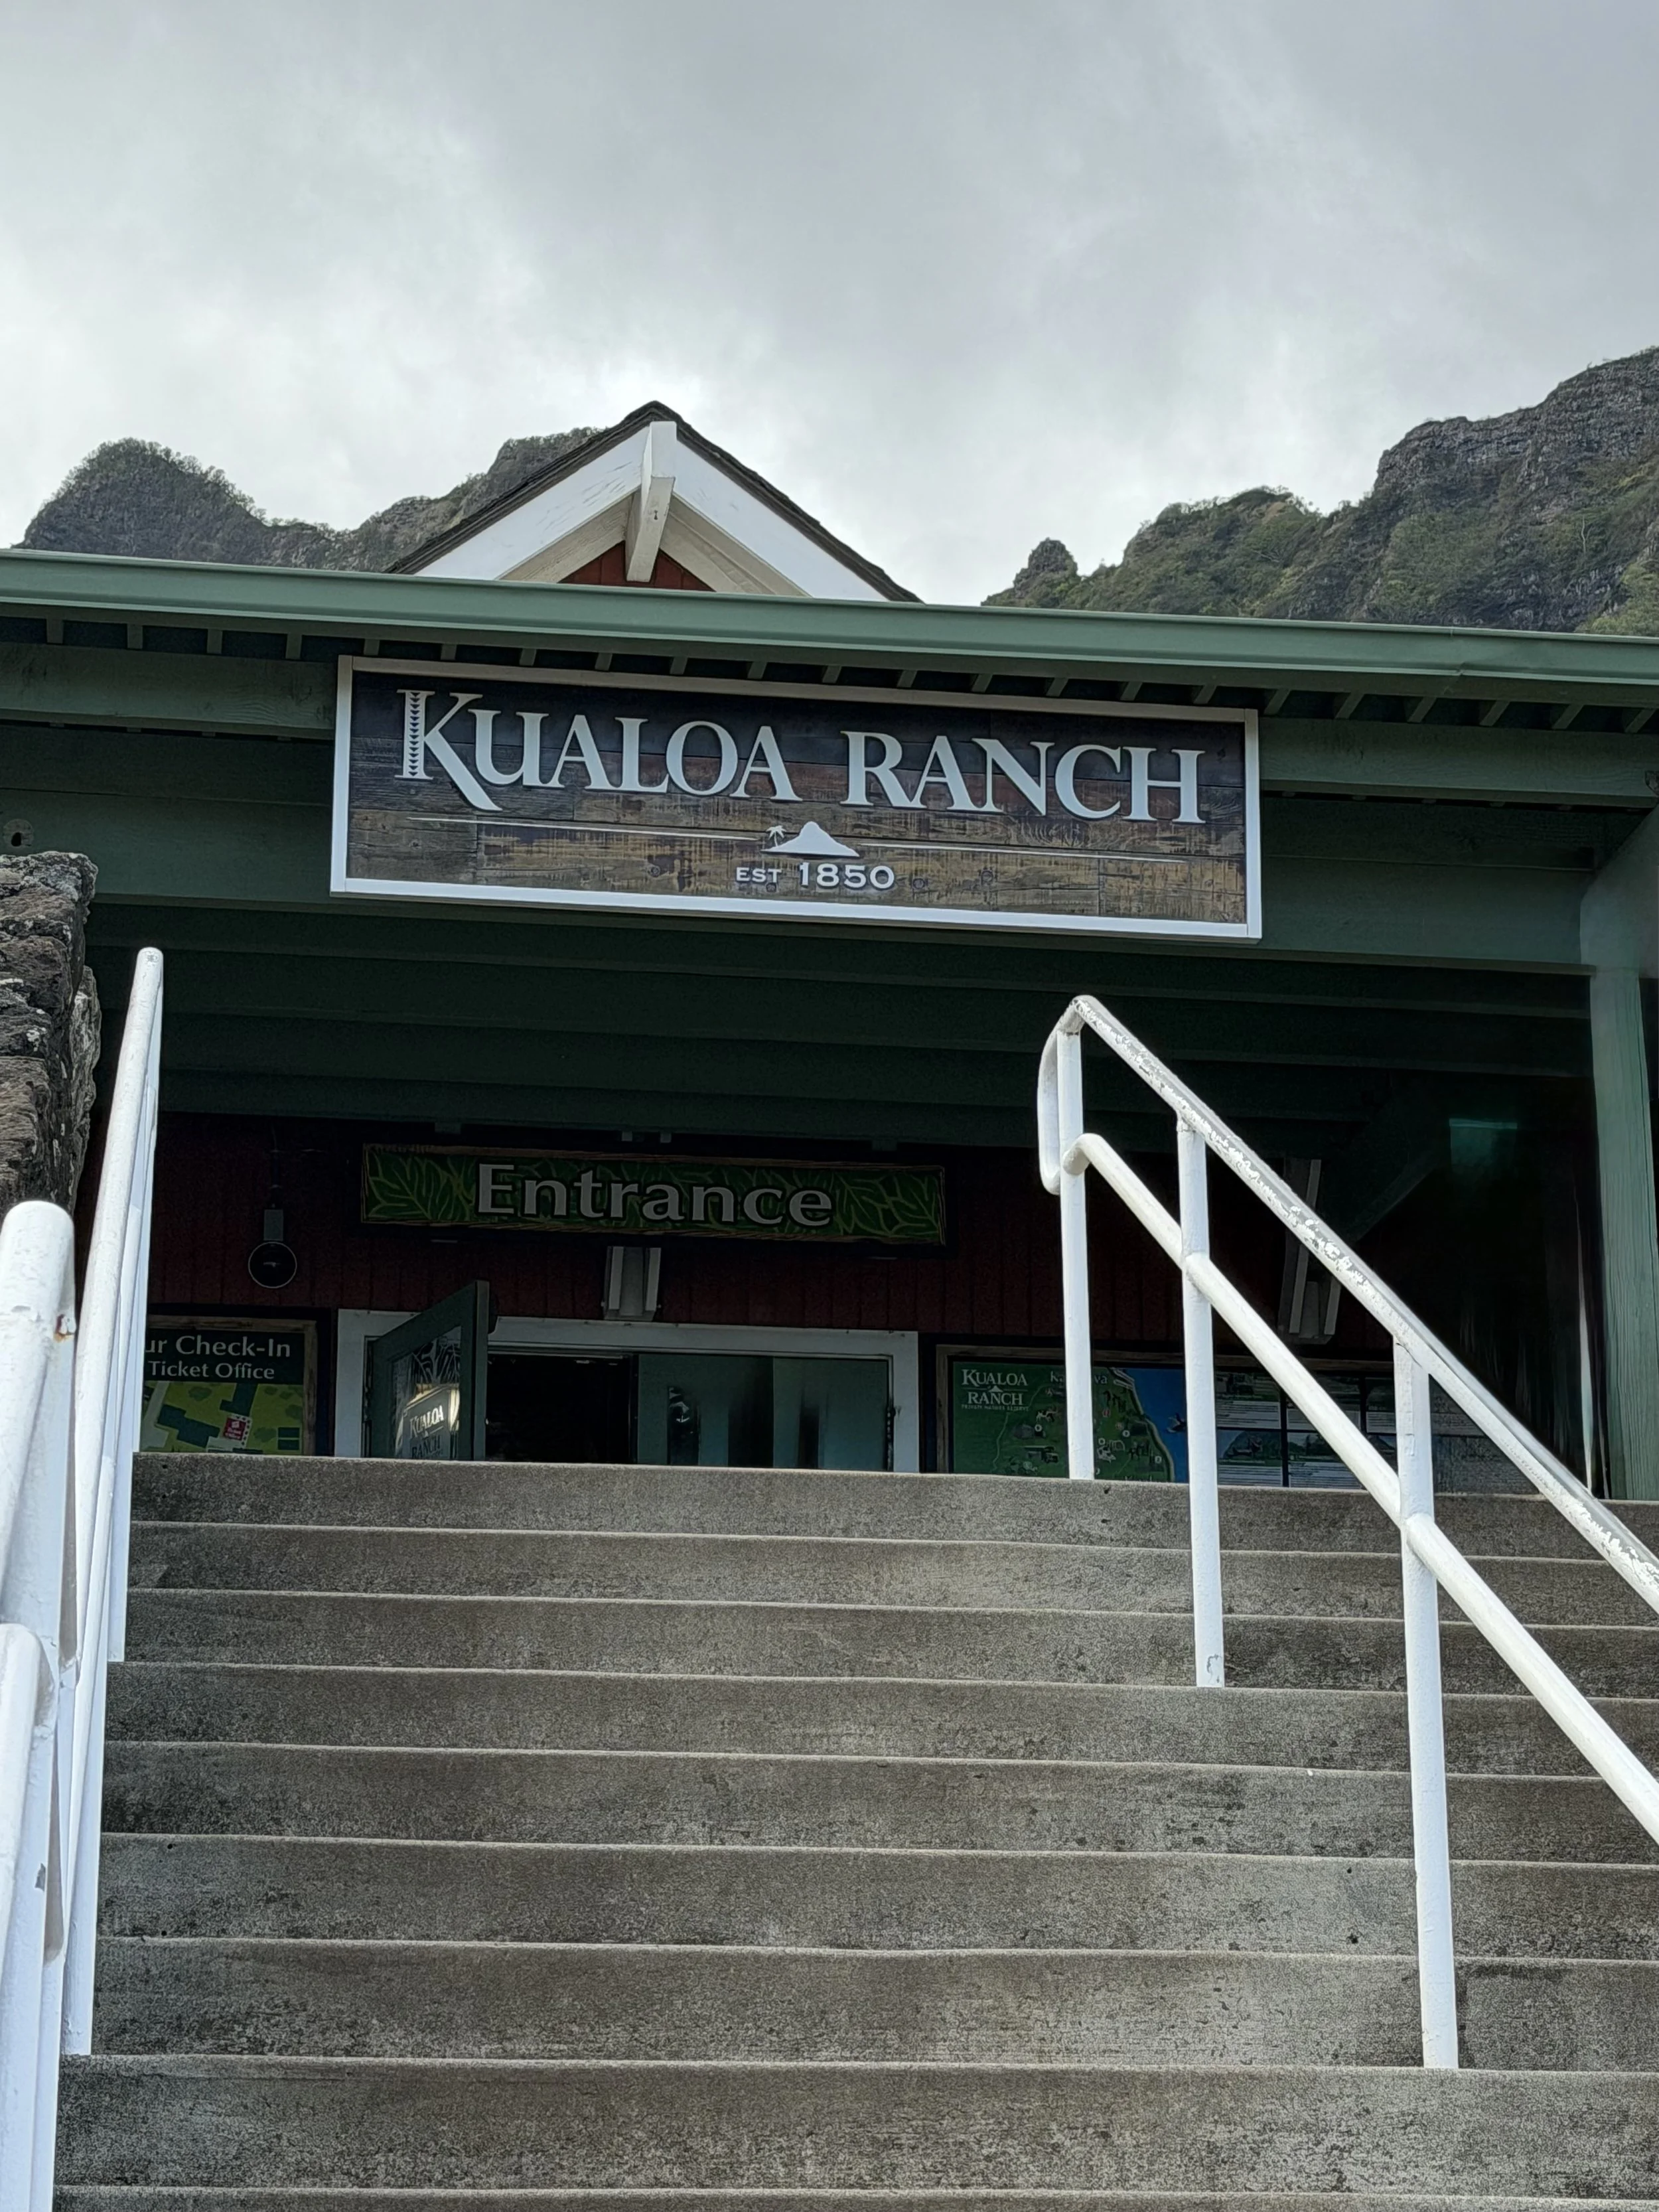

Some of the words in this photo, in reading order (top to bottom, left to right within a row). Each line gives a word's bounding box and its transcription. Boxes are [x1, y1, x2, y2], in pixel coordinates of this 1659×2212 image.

[394, 689, 803, 811] KUALOA
[839, 730, 1206, 824] RANCH
[736, 867, 781, 883] EST
[799, 861, 895, 890] 1850
[478, 1163, 833, 1226] Entrance
[145, 1339, 167, 1353] ur
[175, 1334, 291, 1357] Check-In
[148, 1361, 209, 1377] Ticket
[215, 1363, 275, 1379] Office
[961, 1368, 1029, 1387] KUALOA
[968, 1391, 1023, 1406] RANCH
[409, 1404, 445, 1439] KUALOA
